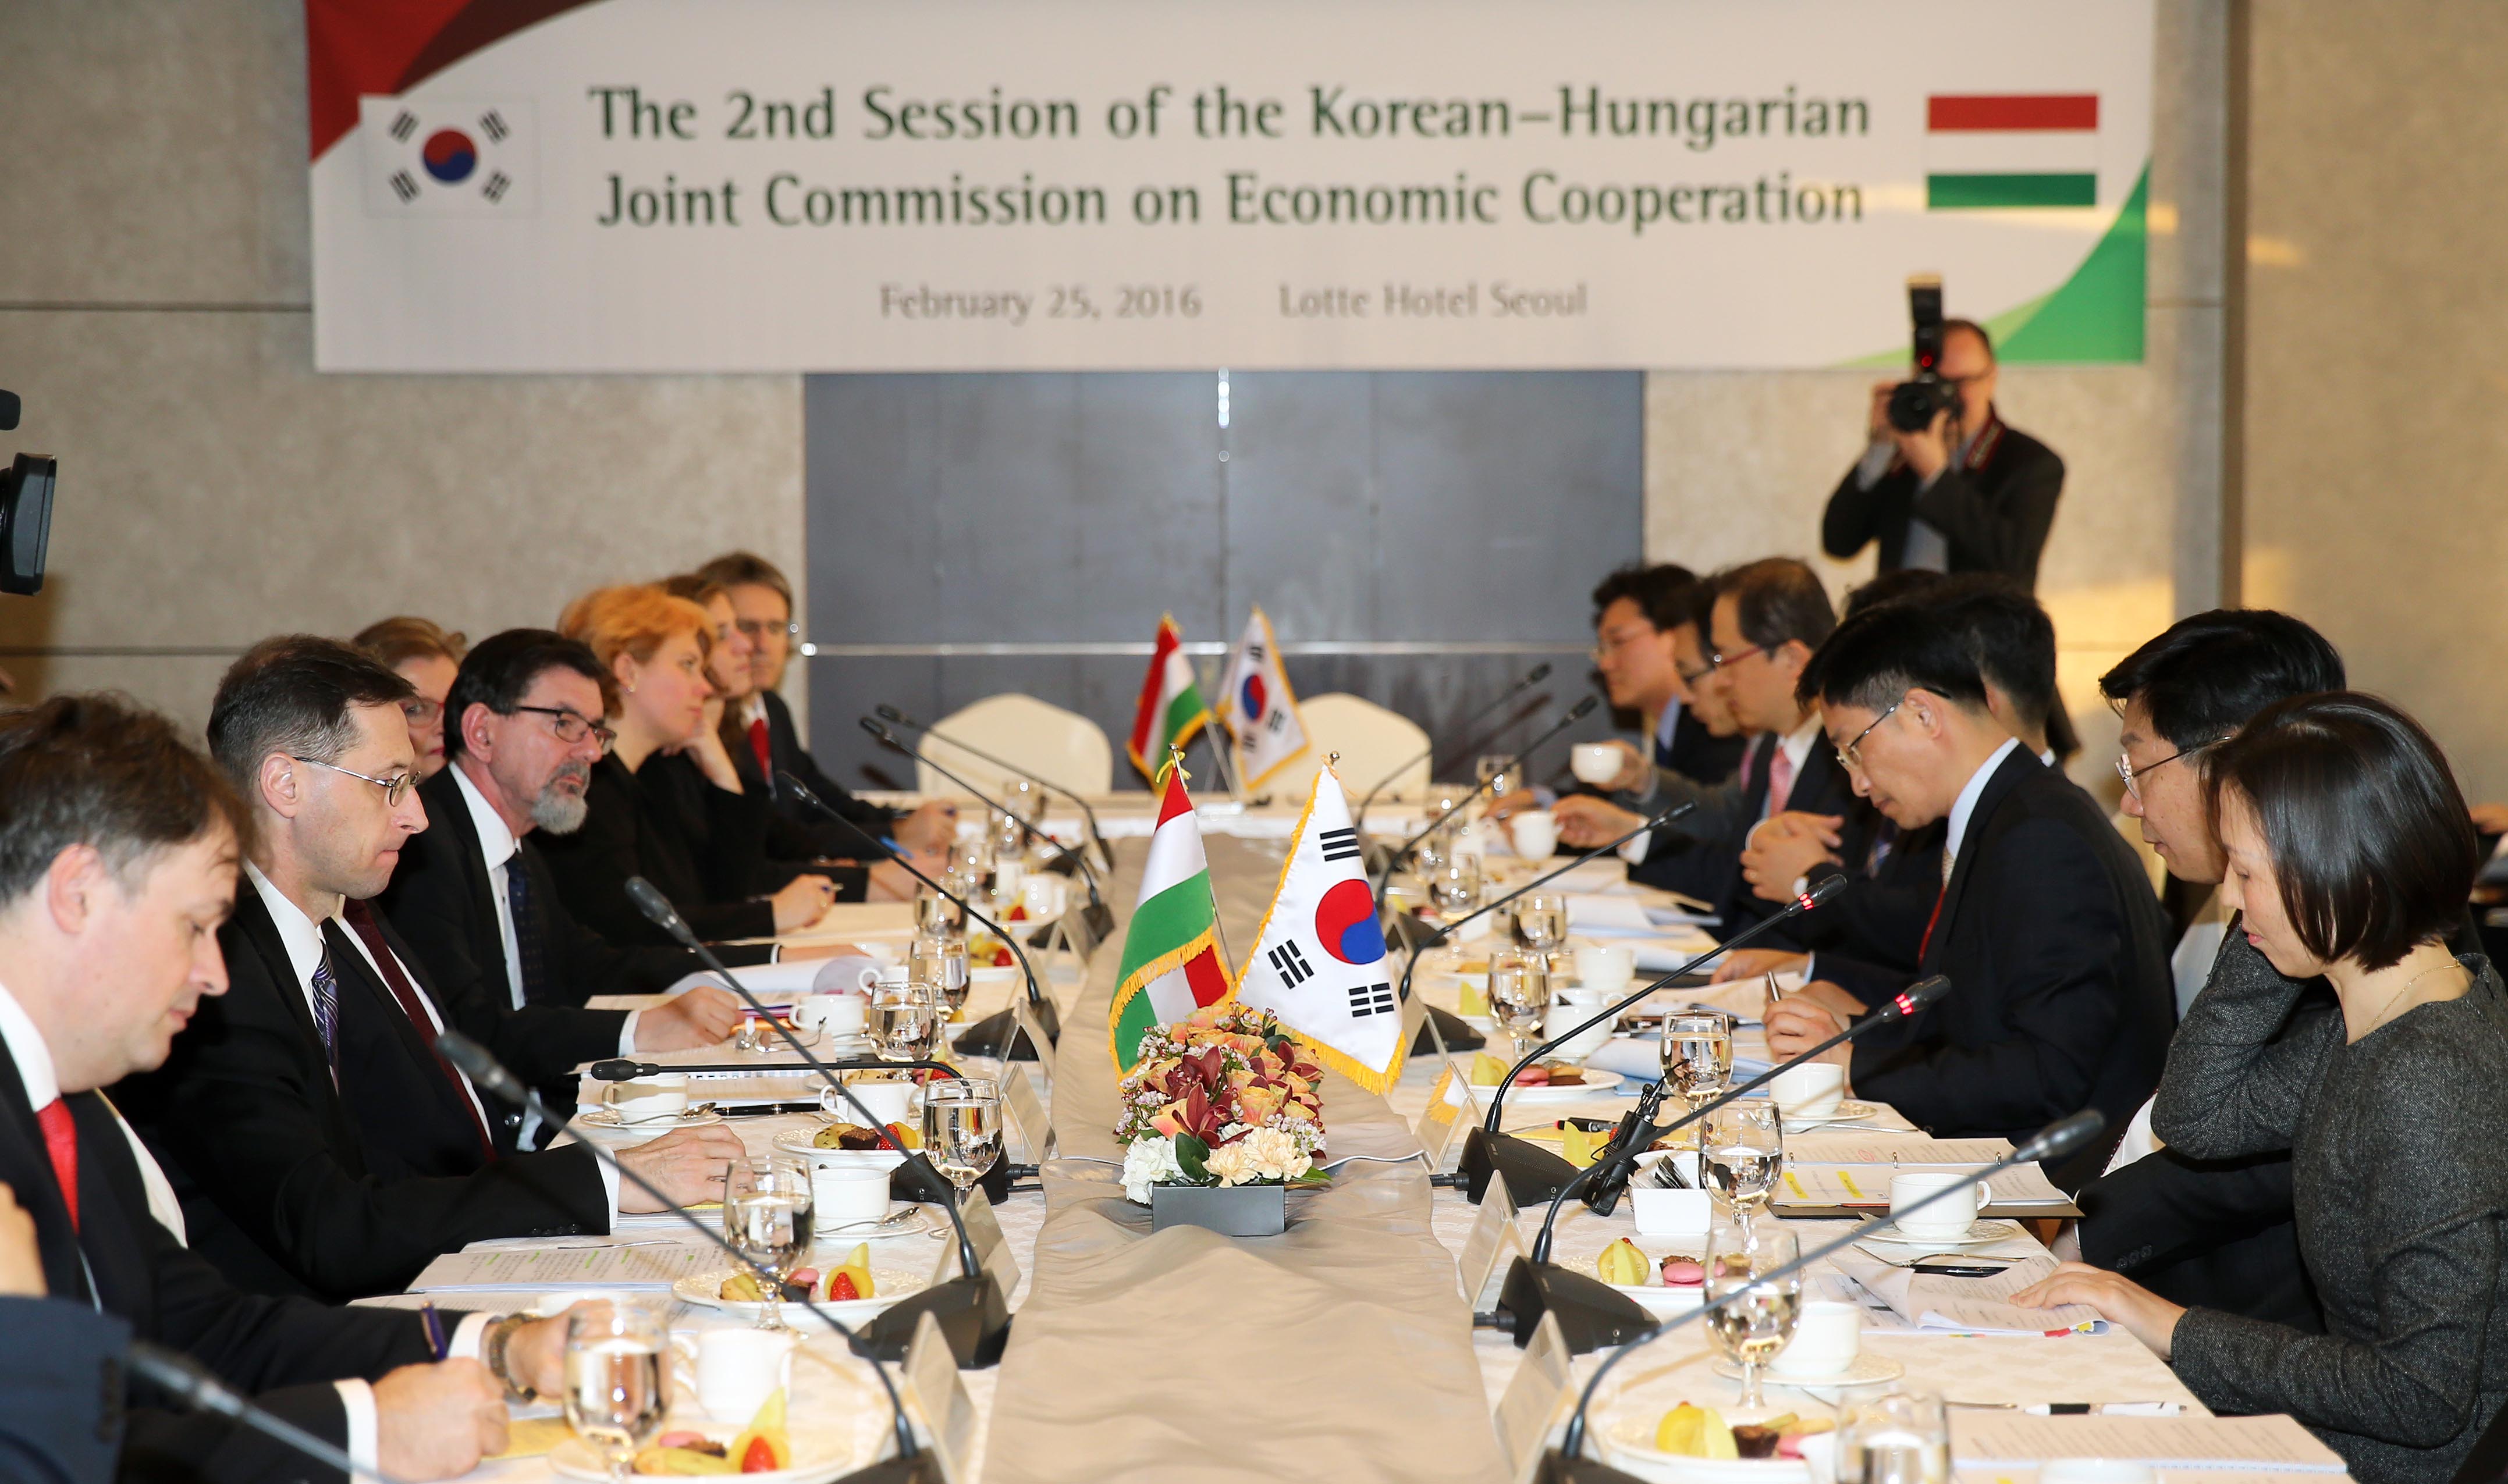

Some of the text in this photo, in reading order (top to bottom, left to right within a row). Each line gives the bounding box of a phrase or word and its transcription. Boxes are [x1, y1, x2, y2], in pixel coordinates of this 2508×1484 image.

[587, 86, 697, 140] The
[726, 87, 834, 139] 2nd
[863, 86, 1078, 138] Session
[1107, 86, 1171, 137] of
[1193, 86, 1282, 137] the
[597, 173, 1863, 234] Joint Commission on Economic Cooperation
[880, 284, 1586, 325] February 25, 2016 Lotte Hotel Seoul
